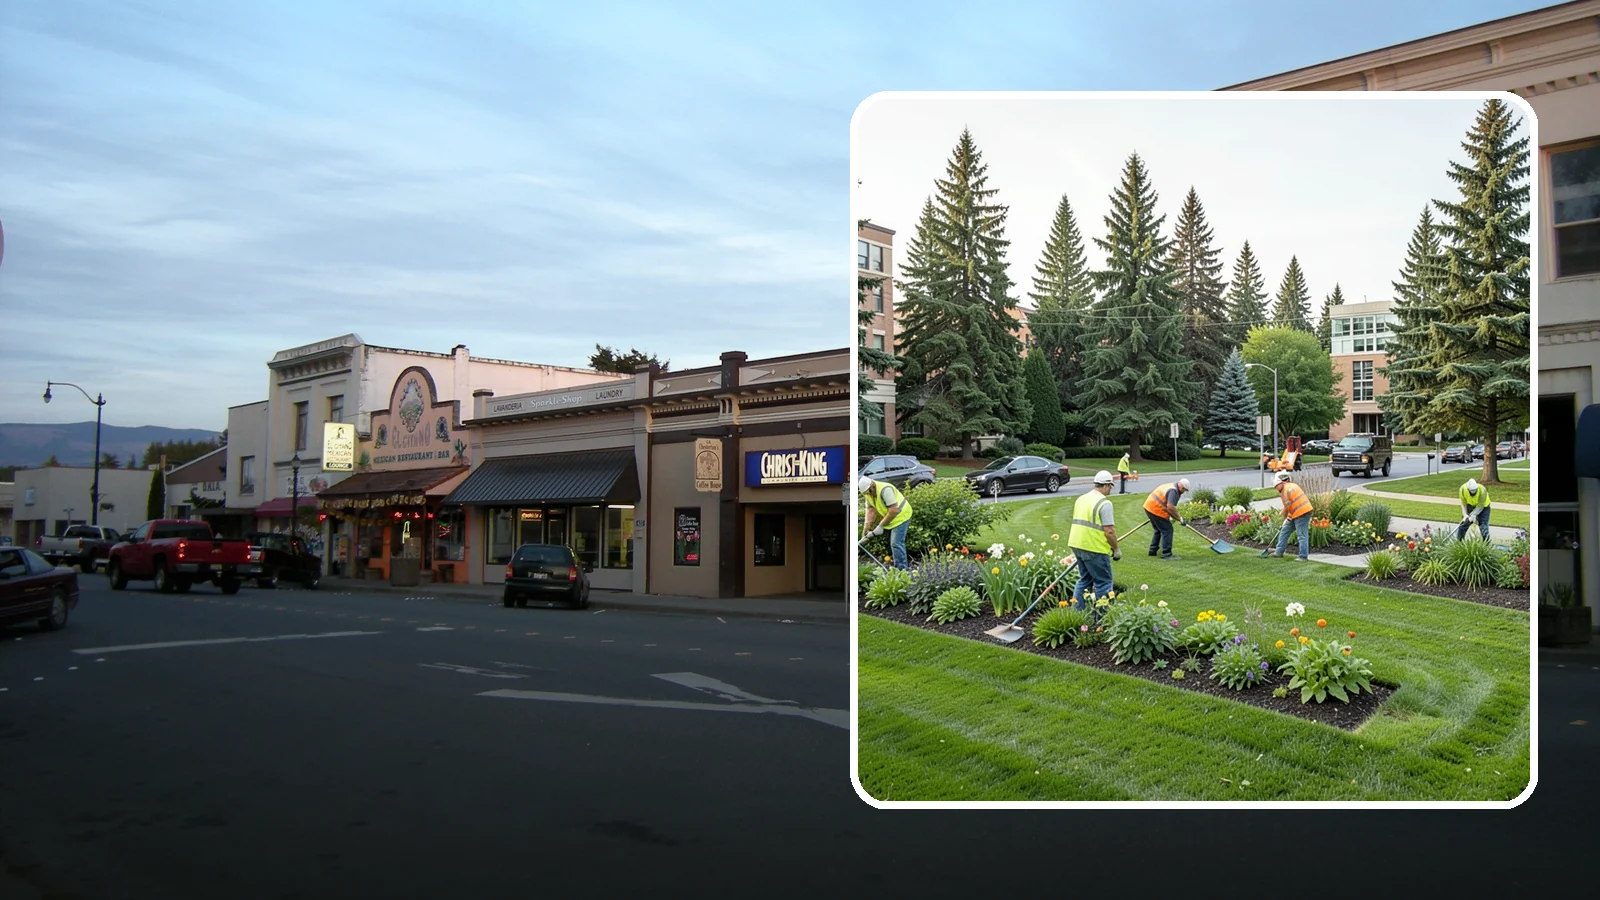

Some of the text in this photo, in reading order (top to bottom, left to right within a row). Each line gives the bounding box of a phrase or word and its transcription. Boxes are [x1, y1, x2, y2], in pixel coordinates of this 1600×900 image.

[493, 389, 623, 413] LAVANDERIA Sparkle Shop LAUNDRY
[373, 455, 396, 464] MEXICAN
[397, 451, 433, 462] RESTAURANT
[438, 450, 450, 459] BAR
[761, 450, 827, 478] CHRIST KING
